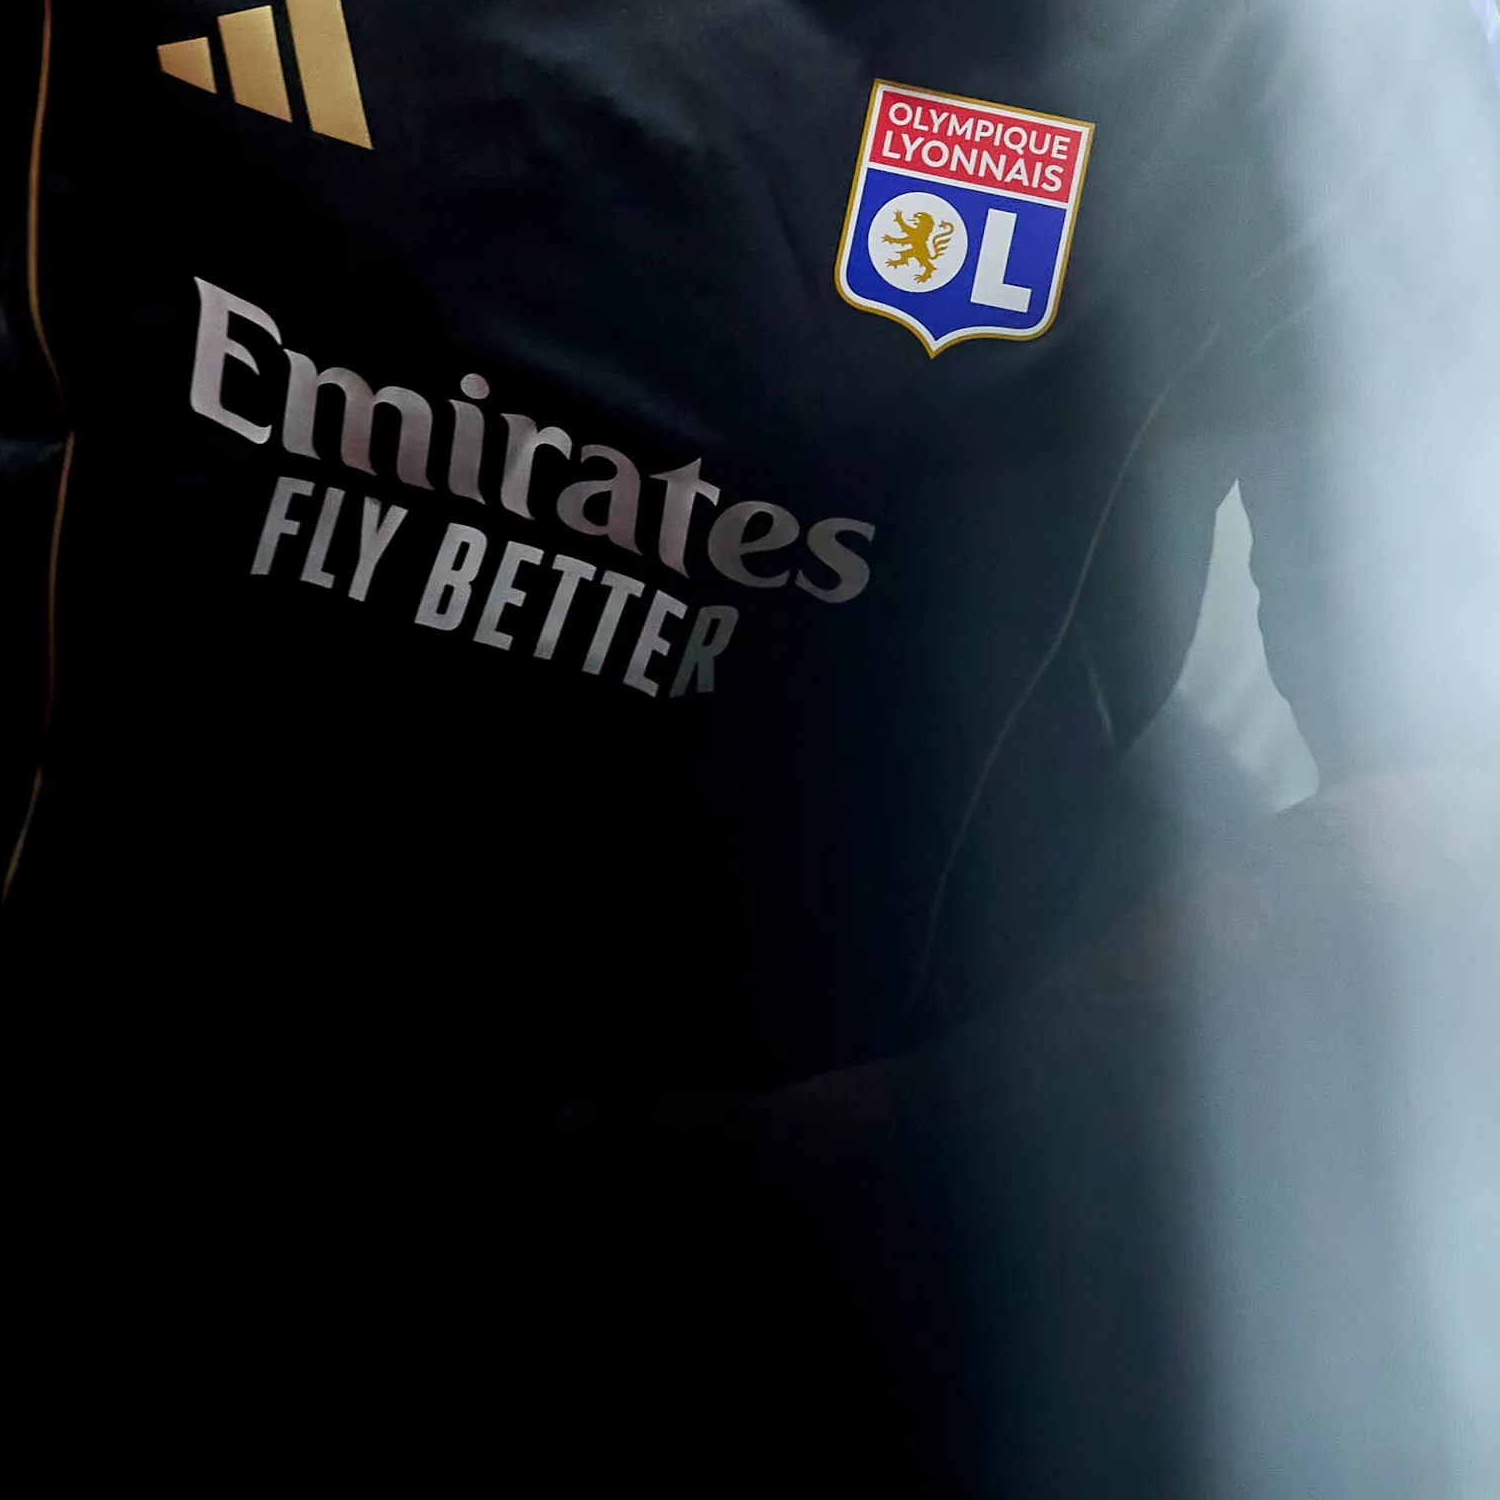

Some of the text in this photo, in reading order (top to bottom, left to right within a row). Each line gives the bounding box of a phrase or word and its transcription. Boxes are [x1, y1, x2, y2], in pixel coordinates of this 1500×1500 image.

[882, 130, 1064, 192] LYONNAIS
[888, 102, 1071, 160] OLYMPIQUE
[190, 276, 875, 604] Emirates
[250, 477, 740, 698] FLY BETTER
